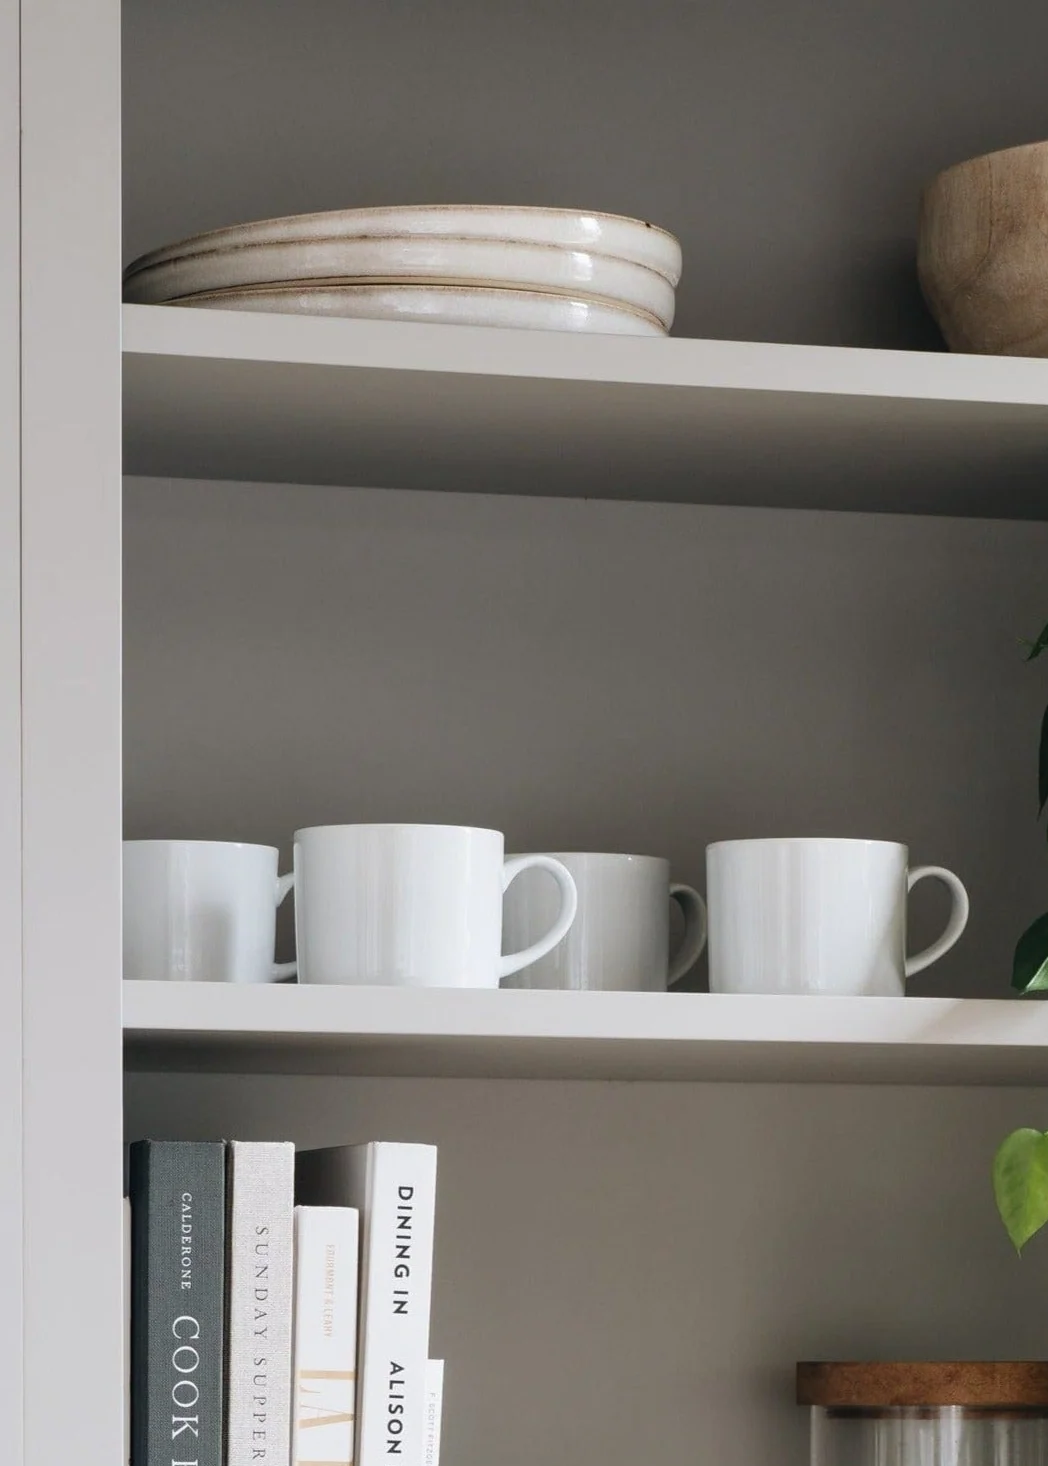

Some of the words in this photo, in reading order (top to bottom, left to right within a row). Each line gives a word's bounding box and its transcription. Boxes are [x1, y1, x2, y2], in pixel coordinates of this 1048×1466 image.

[180, 1192, 193, 1290] CALDERONE
[393, 1185, 414, 1278] DINING
[253, 1226, 269, 1340] SUNDAY
[392, 1290, 408, 1315] IN
[171, 1315, 200, 1441] COOK
[299, 1369, 355, 1429] LA
[385, 1361, 405, 1455] ALISON
